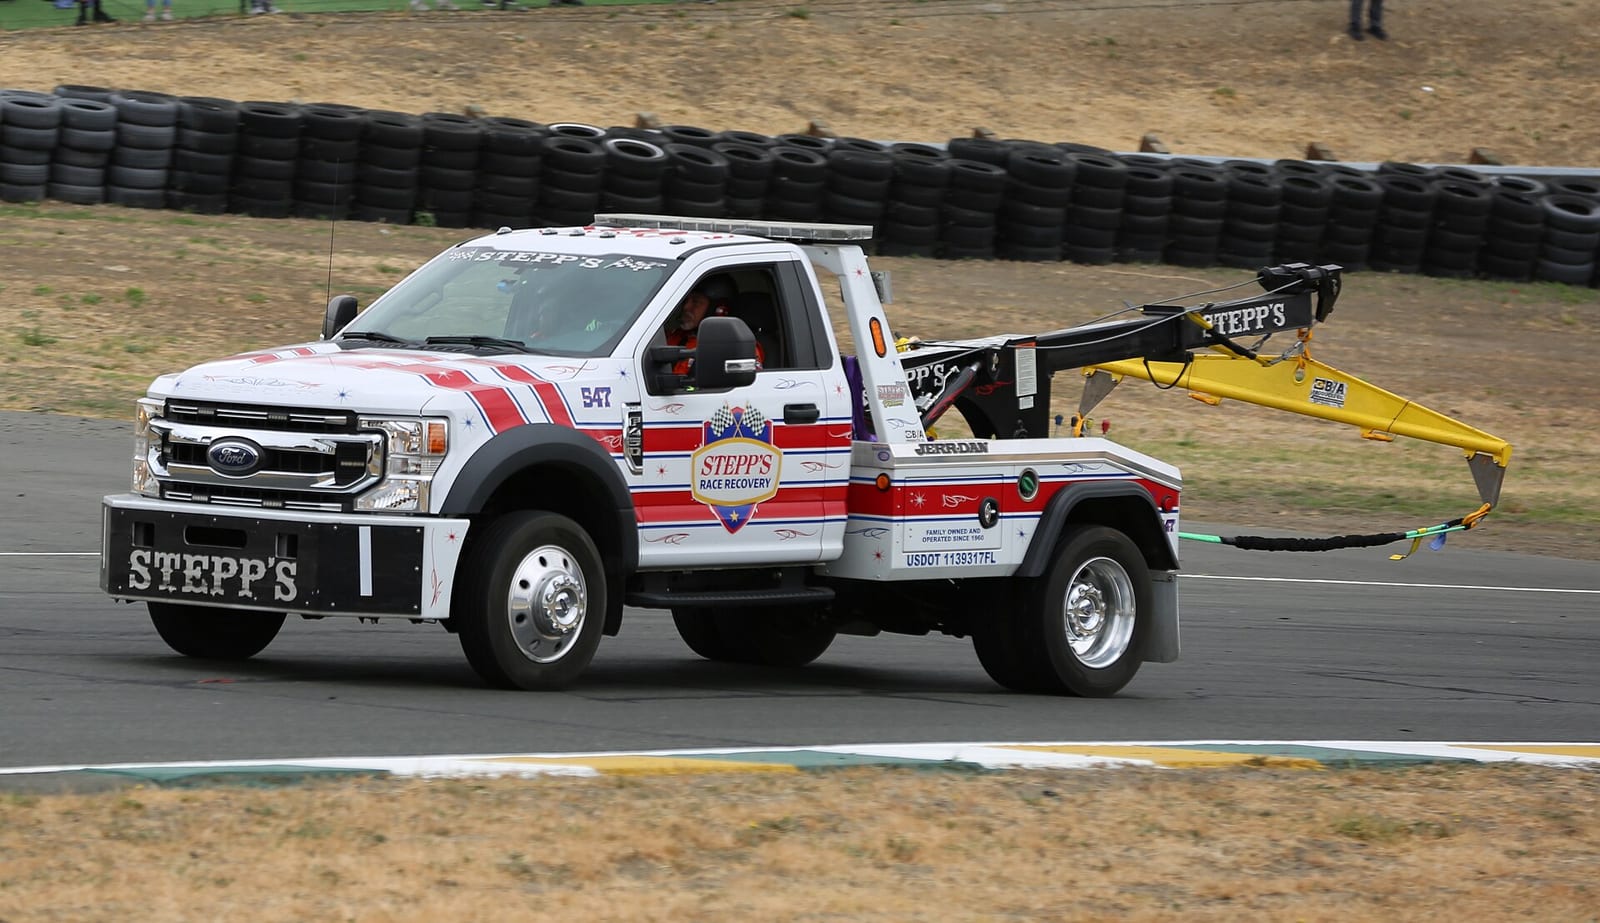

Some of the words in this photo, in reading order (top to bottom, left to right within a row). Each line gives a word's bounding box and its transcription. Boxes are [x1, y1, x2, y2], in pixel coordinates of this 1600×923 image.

[475, 251, 603, 268] STEPP'S
[581, 387, 611, 408] 547
[218, 447, 247, 465] Ford
[701, 454, 773, 476] STEPP'S
[700, 479, 722, 490] RACE
[724, 478, 772, 490] RECOVERY
[926, 528, 946, 536] FAMILY
[907, 553, 941, 567] USDOT
[944, 552, 996, 566] 1139317FL
[128, 550, 298, 602] STEPP'S
